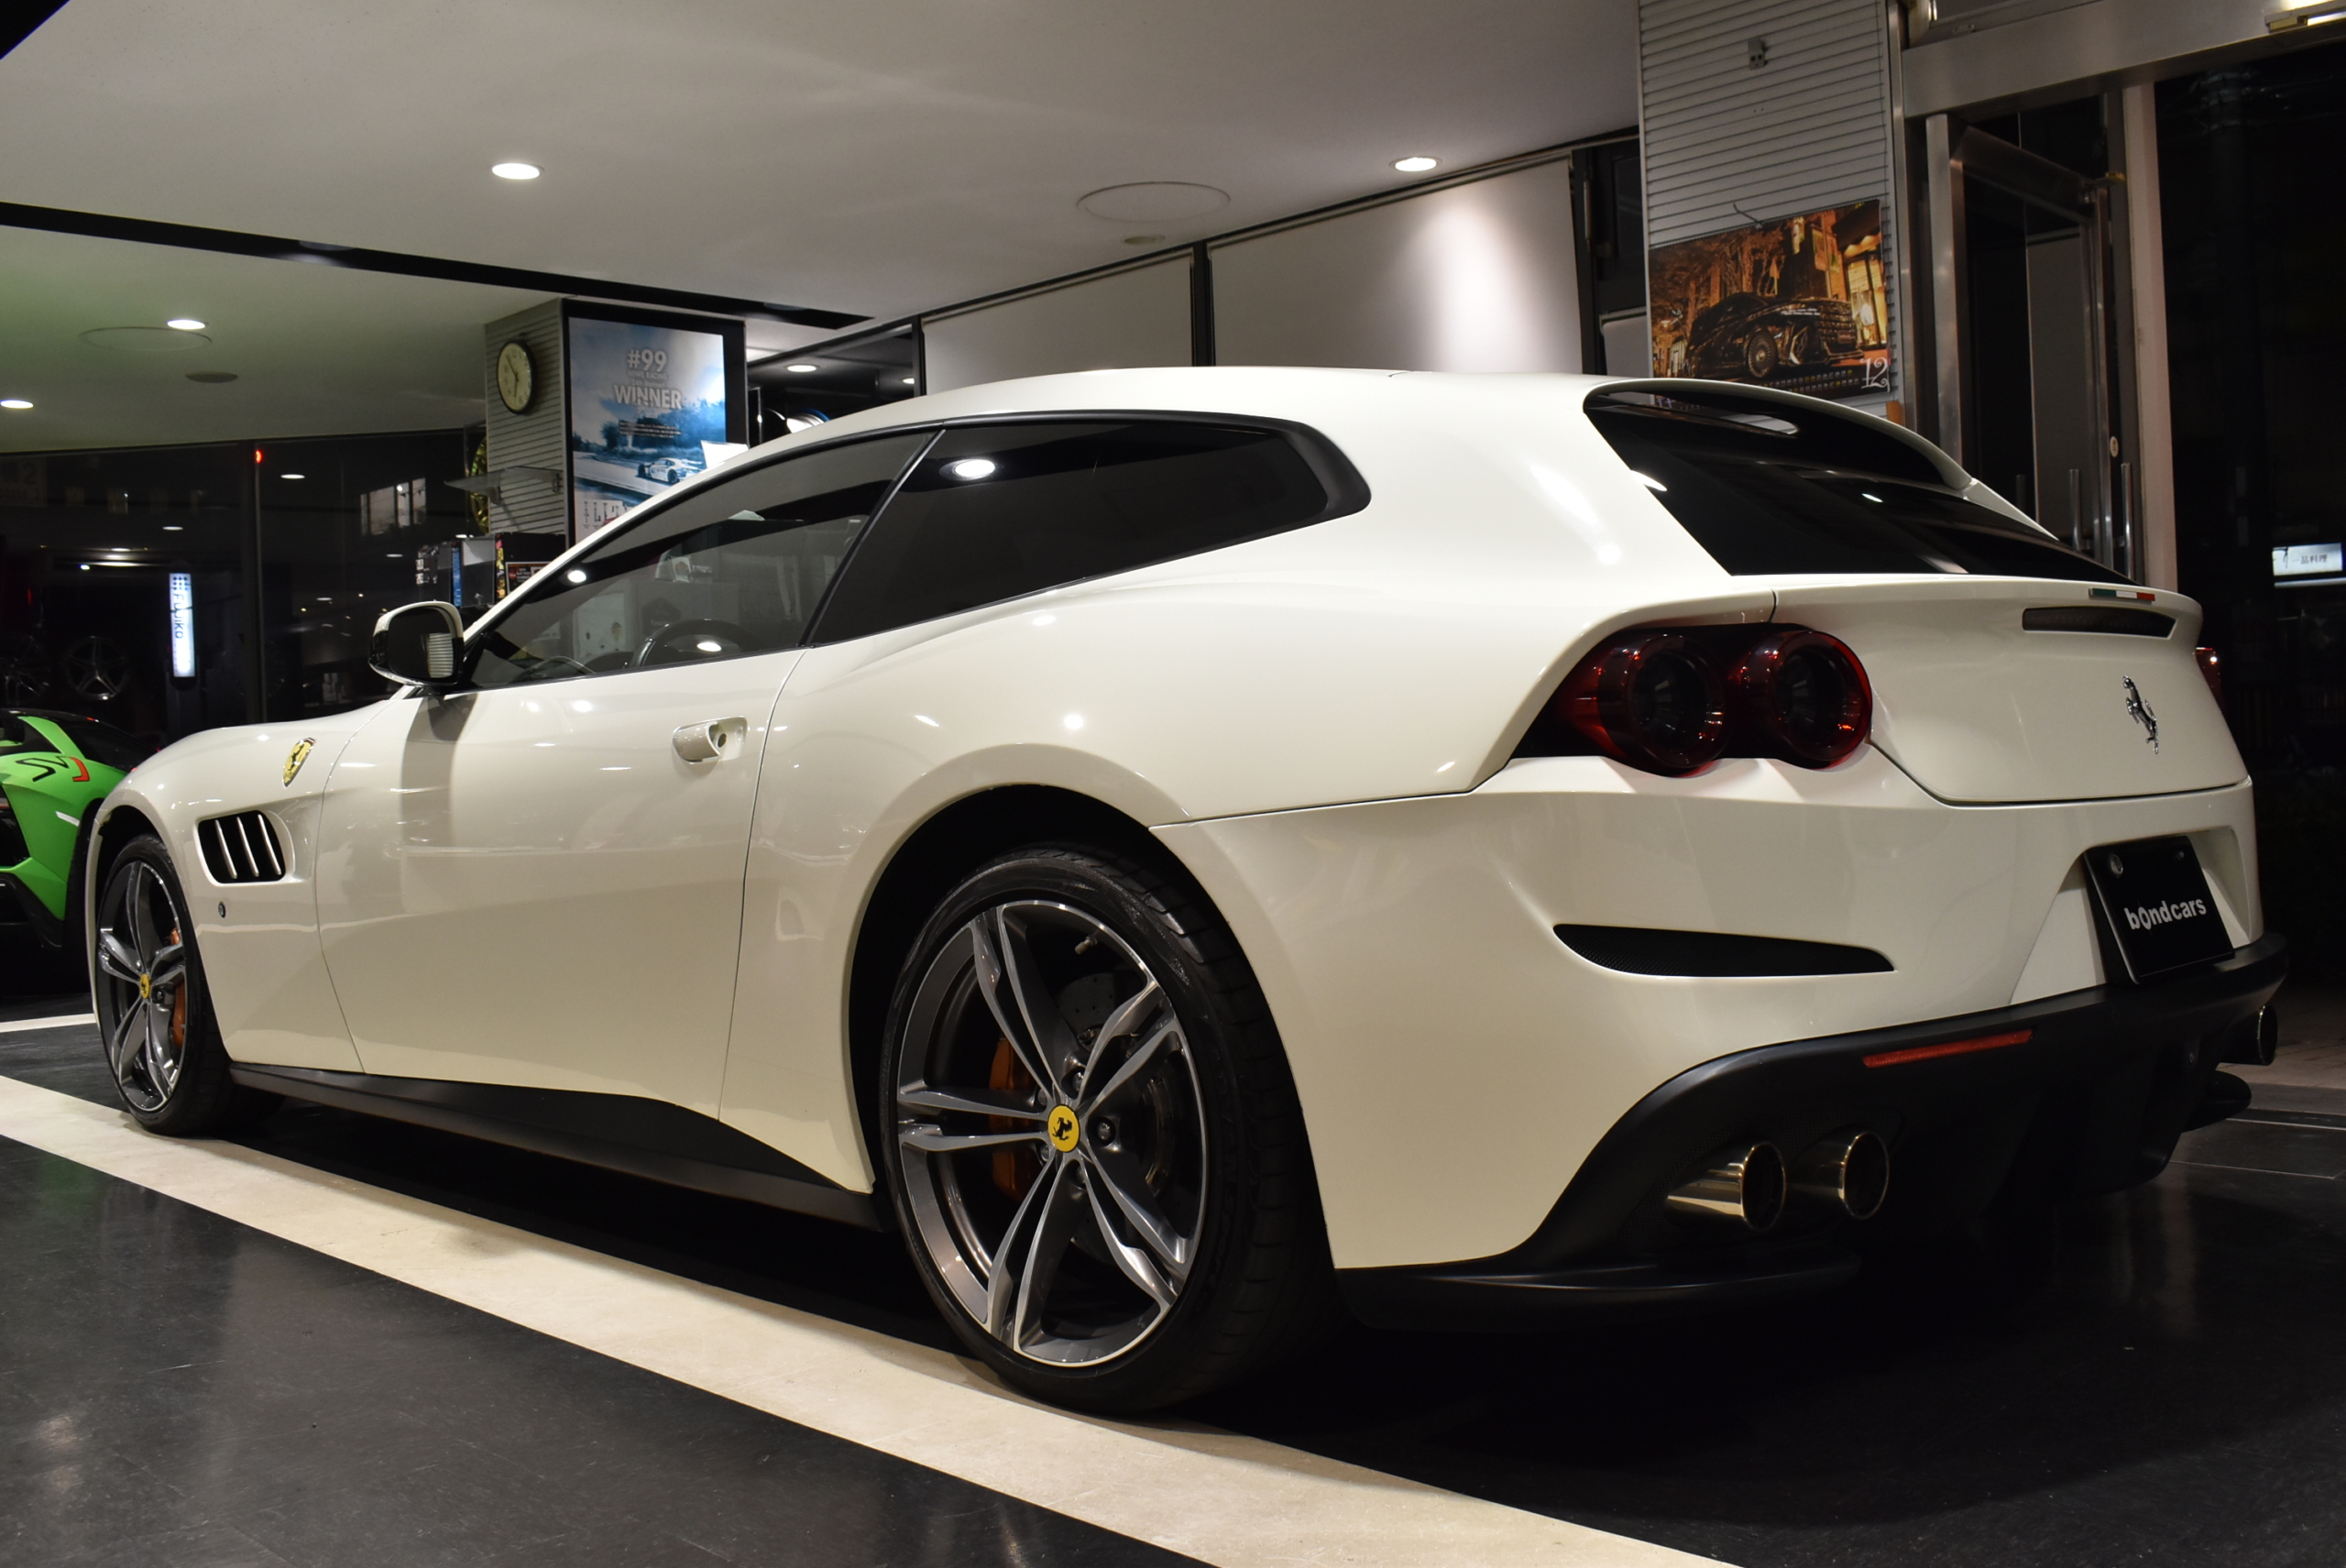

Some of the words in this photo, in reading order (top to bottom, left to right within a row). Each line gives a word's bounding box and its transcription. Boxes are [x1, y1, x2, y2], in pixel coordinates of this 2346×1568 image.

[627, 349, 667, 372] #99
[1860, 356, 1889, 390] 12
[614, 386, 682, 410] WINNER
